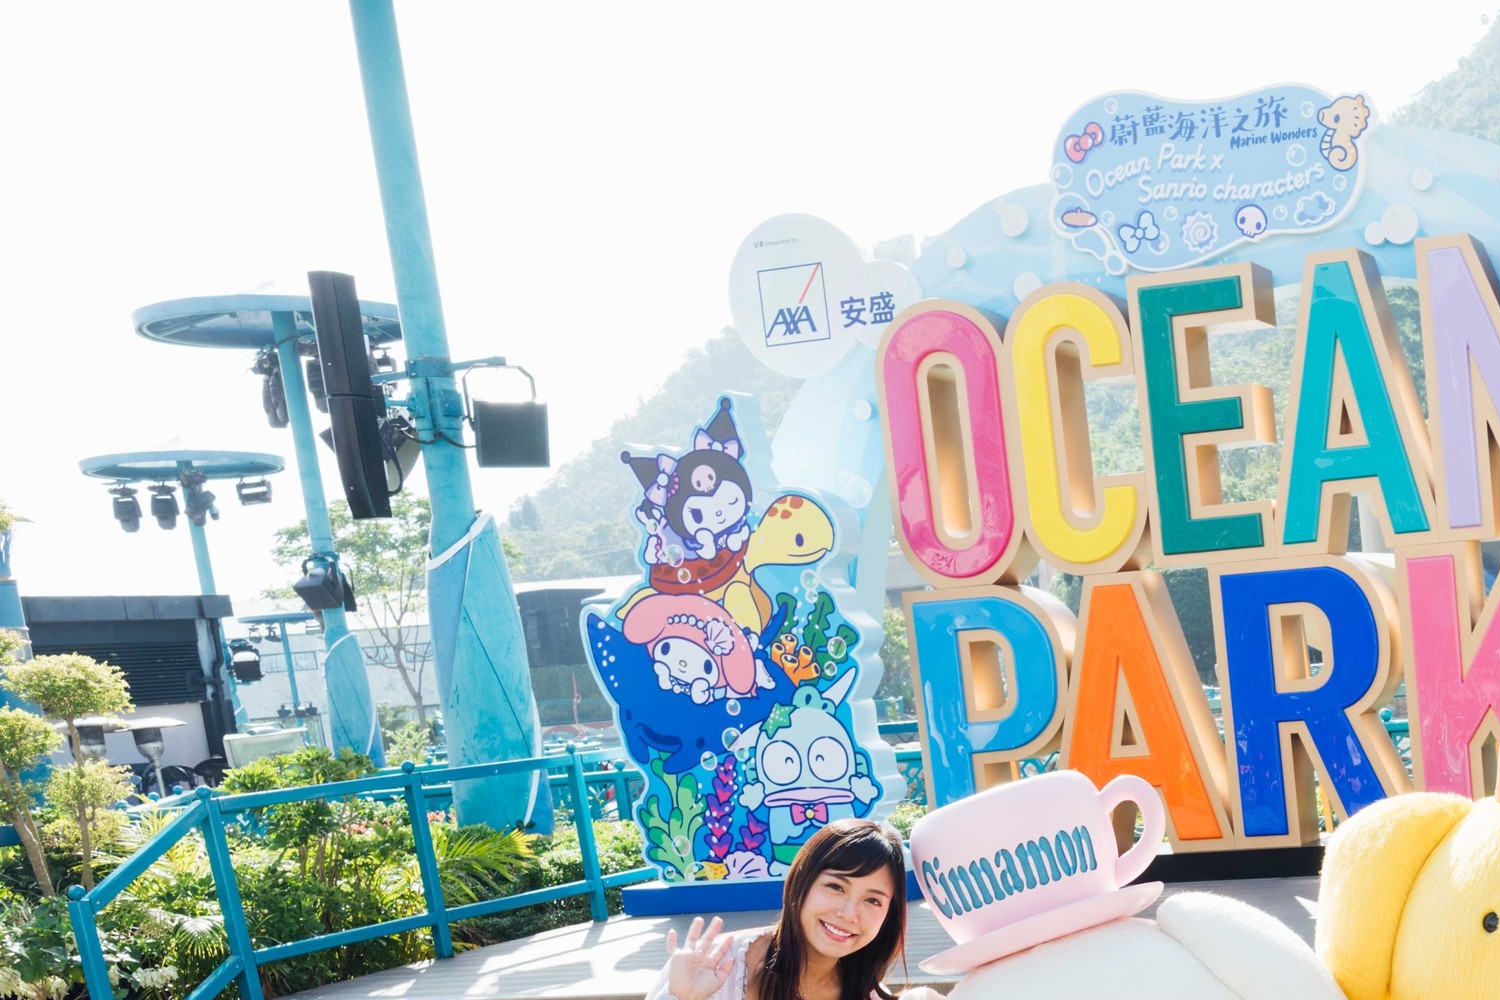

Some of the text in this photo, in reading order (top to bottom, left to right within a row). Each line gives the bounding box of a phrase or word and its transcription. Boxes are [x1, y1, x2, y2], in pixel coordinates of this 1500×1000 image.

[1109, 95, 1288, 146] 蔚藍海洋之旅
[1230, 127, 1318, 149] Marine Wonders
[1085, 155, 1151, 198] Ocean
[1157, 142, 1207, 173] Park
[1138, 161, 1326, 204] Sanrio characters
[766, 305, 818, 338] AXA
[840, 291, 896, 329] 安盛
[922, 824, 1098, 920] Cinnamon
